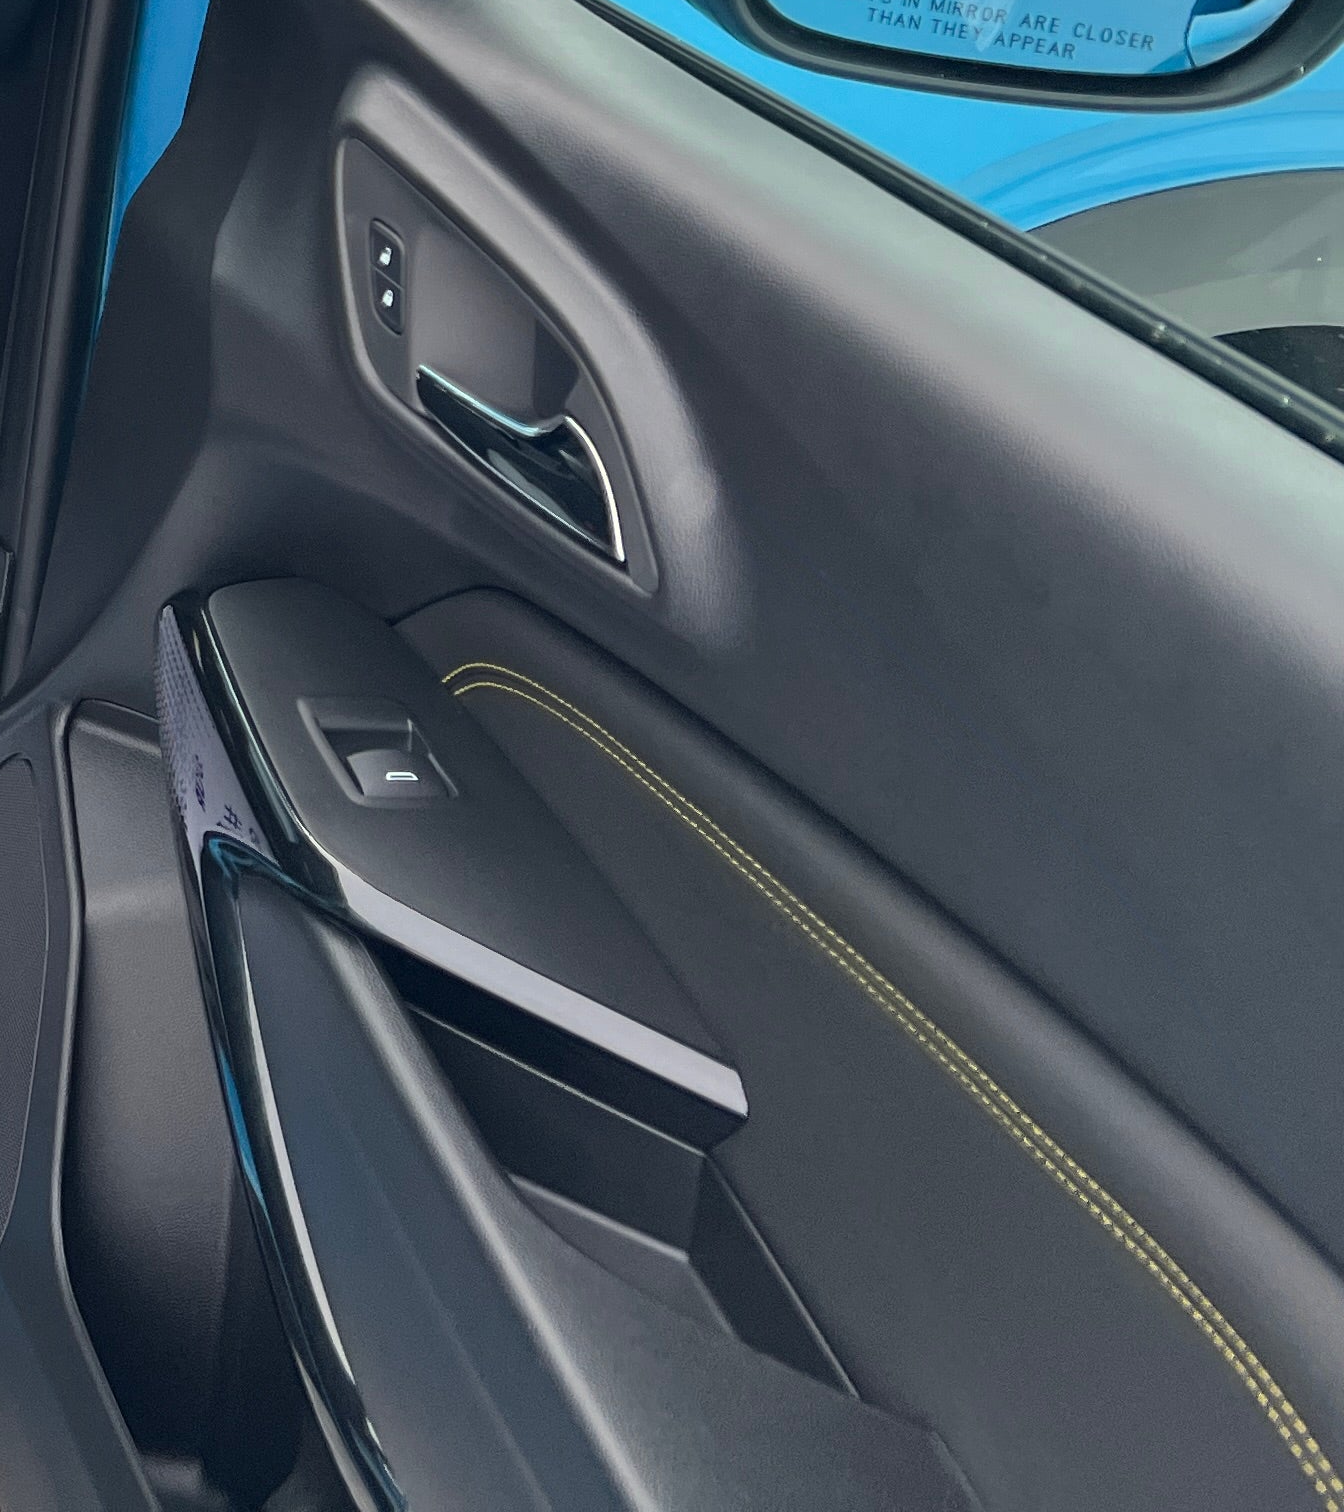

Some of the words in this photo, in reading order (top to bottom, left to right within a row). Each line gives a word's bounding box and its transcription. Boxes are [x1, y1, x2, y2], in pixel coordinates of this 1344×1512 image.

[868, 6, 922, 31] THAN
[930, 18, 984, 41] THEY
[994, 30, 1077, 60] APPEAR
[1020, 12, 1061, 35] ARE
[1071, 21, 1155, 52] CLOSER
